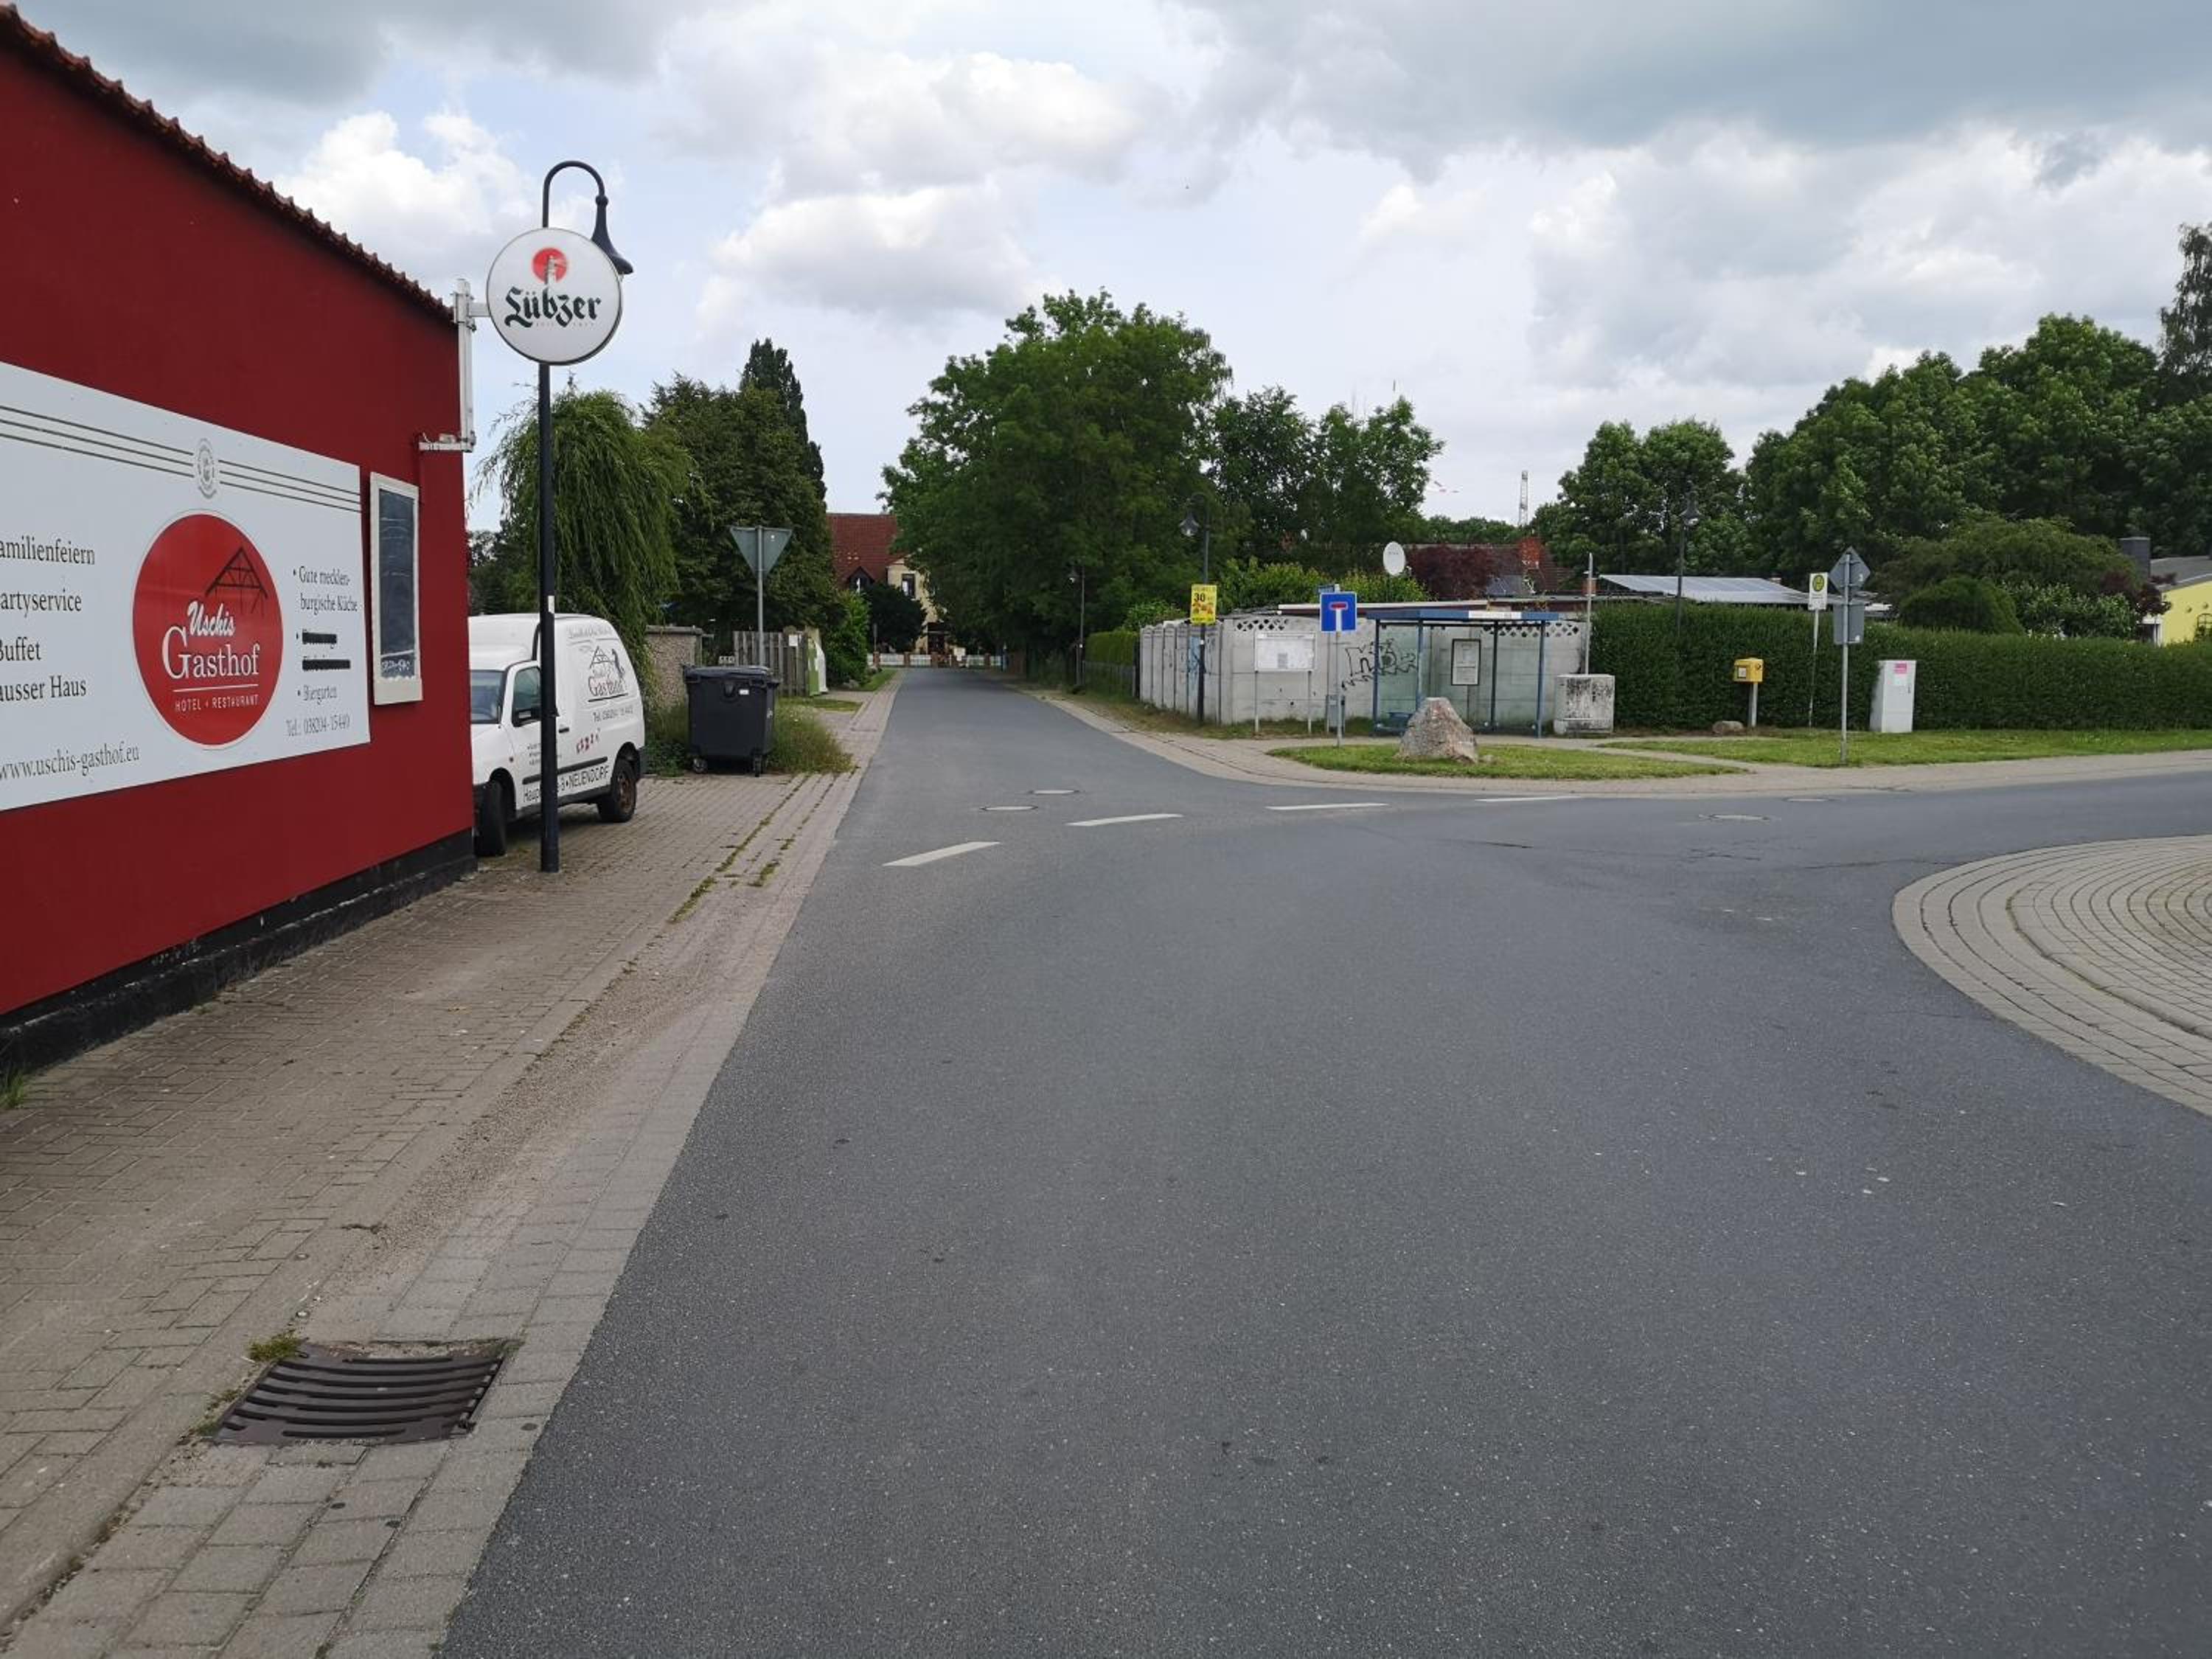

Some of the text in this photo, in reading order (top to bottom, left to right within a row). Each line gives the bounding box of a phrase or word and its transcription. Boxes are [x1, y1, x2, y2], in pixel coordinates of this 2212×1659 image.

[504, 286, 602, 328] Lübzer
[299, 566, 318, 583] Gute
[300, 592, 358, 615] burgische Küche
[1194, 592, 1206, 602] 30
[187, 600, 235, 636] Uschis
[161, 626, 260, 679] Gasthof
[49, 675, 87, 698] Haus
[175, 694, 259, 712] HOTEL RESTAURANT
